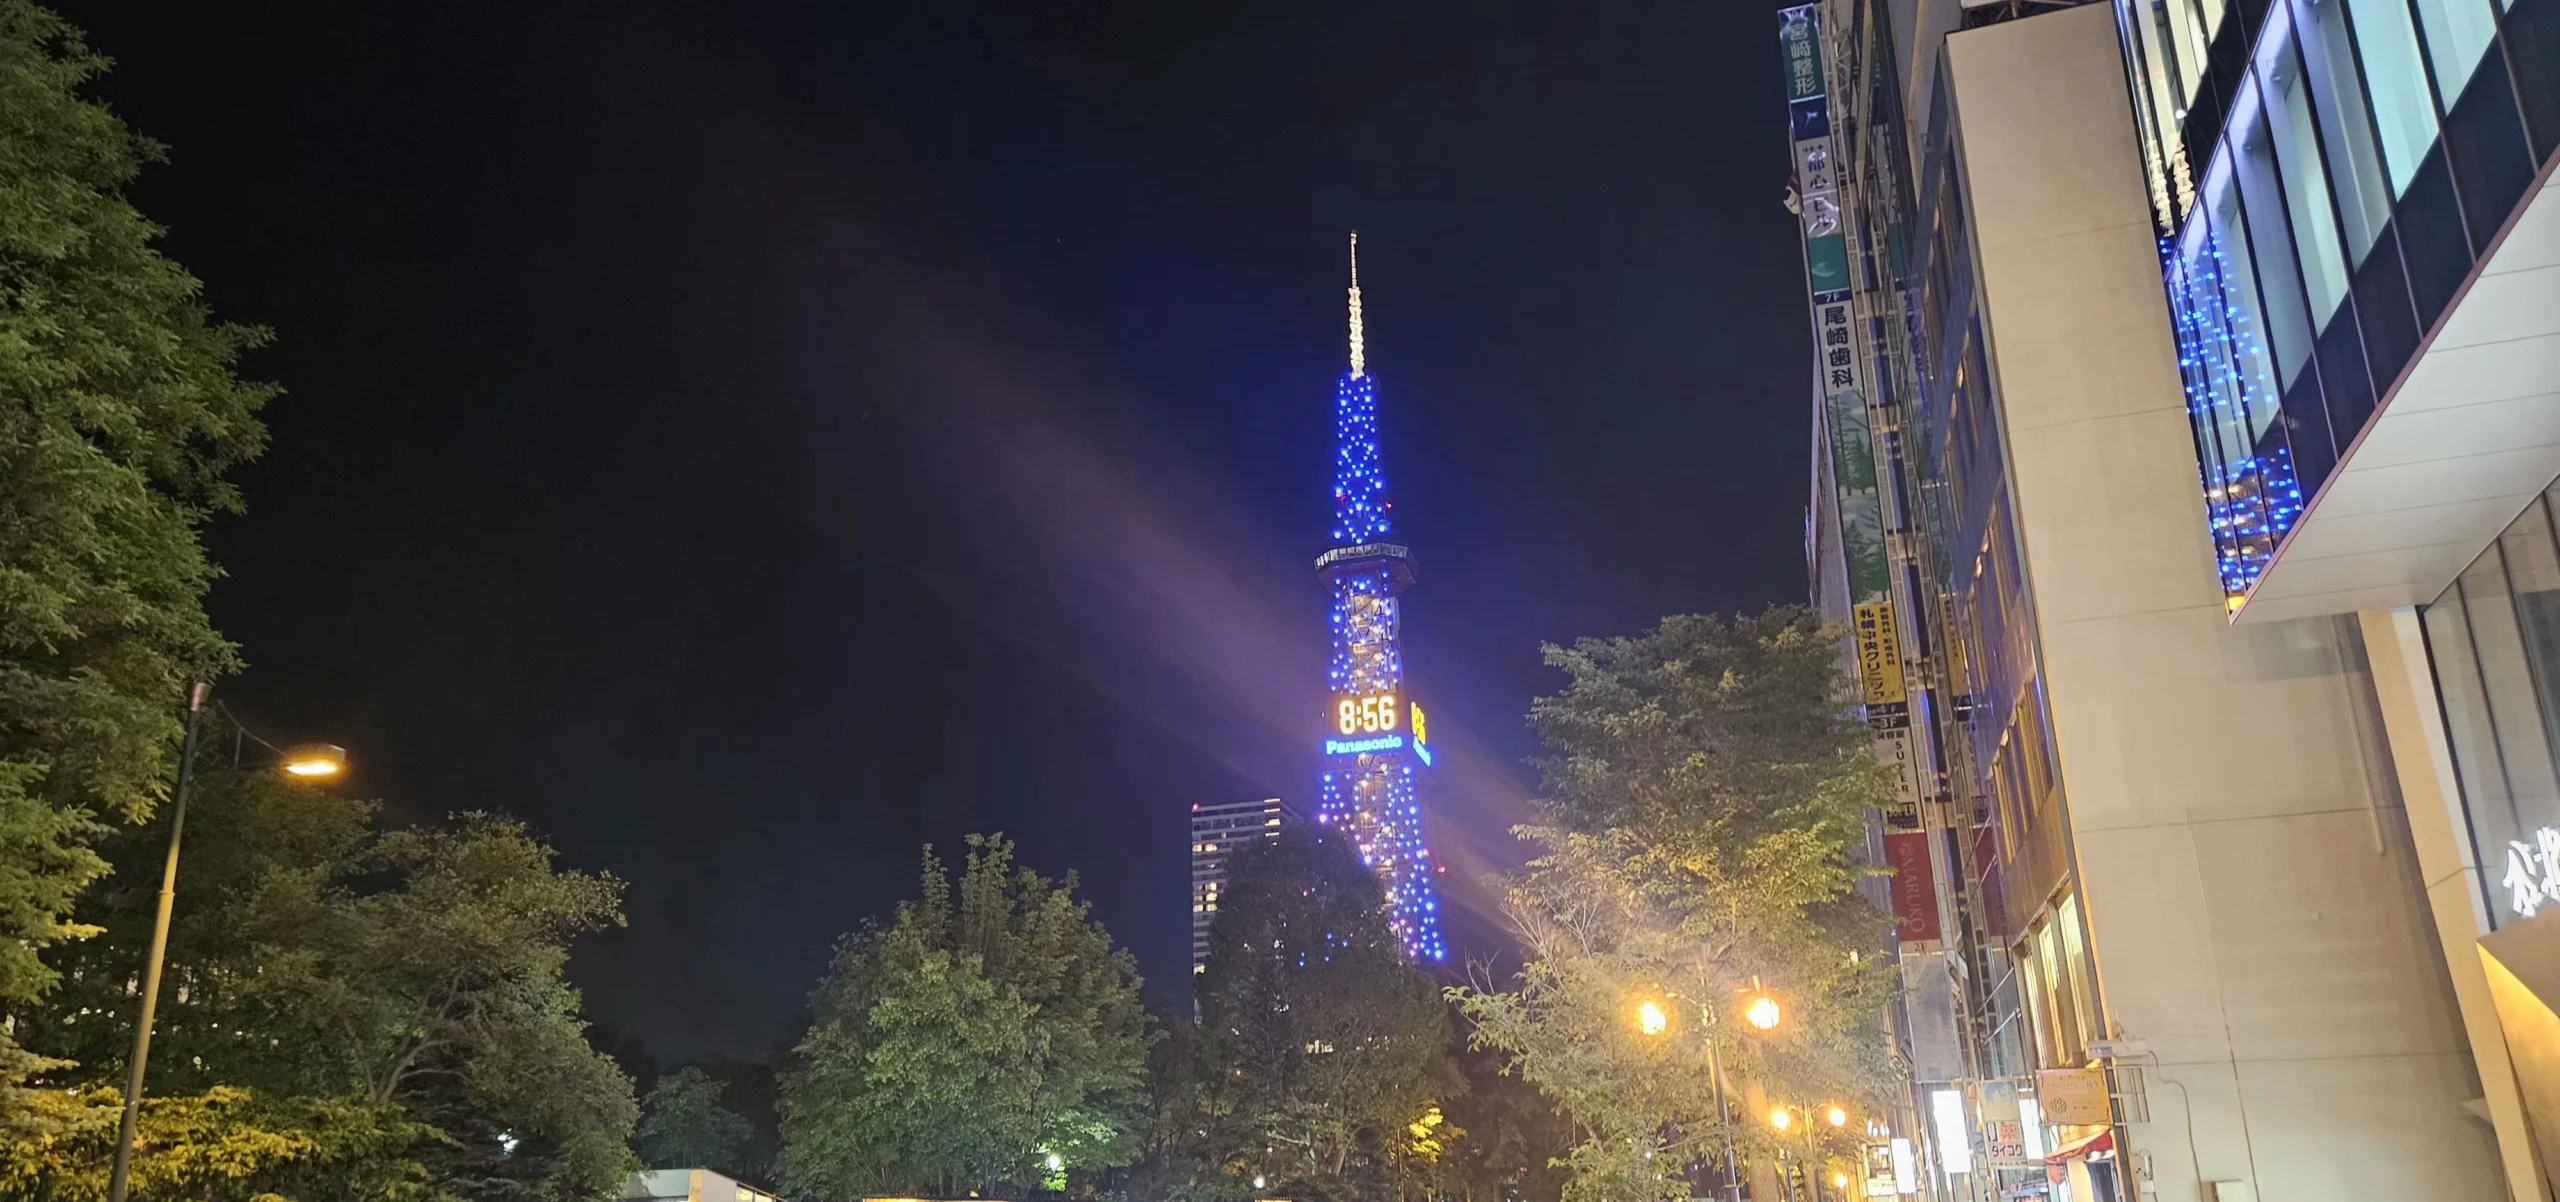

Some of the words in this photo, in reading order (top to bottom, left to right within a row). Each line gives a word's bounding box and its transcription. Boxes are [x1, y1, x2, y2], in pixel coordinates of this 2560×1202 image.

[1825, 292, 1840, 303] 7F
[1339, 696, 1396, 735] 8:56
[1326, 735, 1402, 755] Panasonic
[1902, 858, 1926, 933] MARUKO
